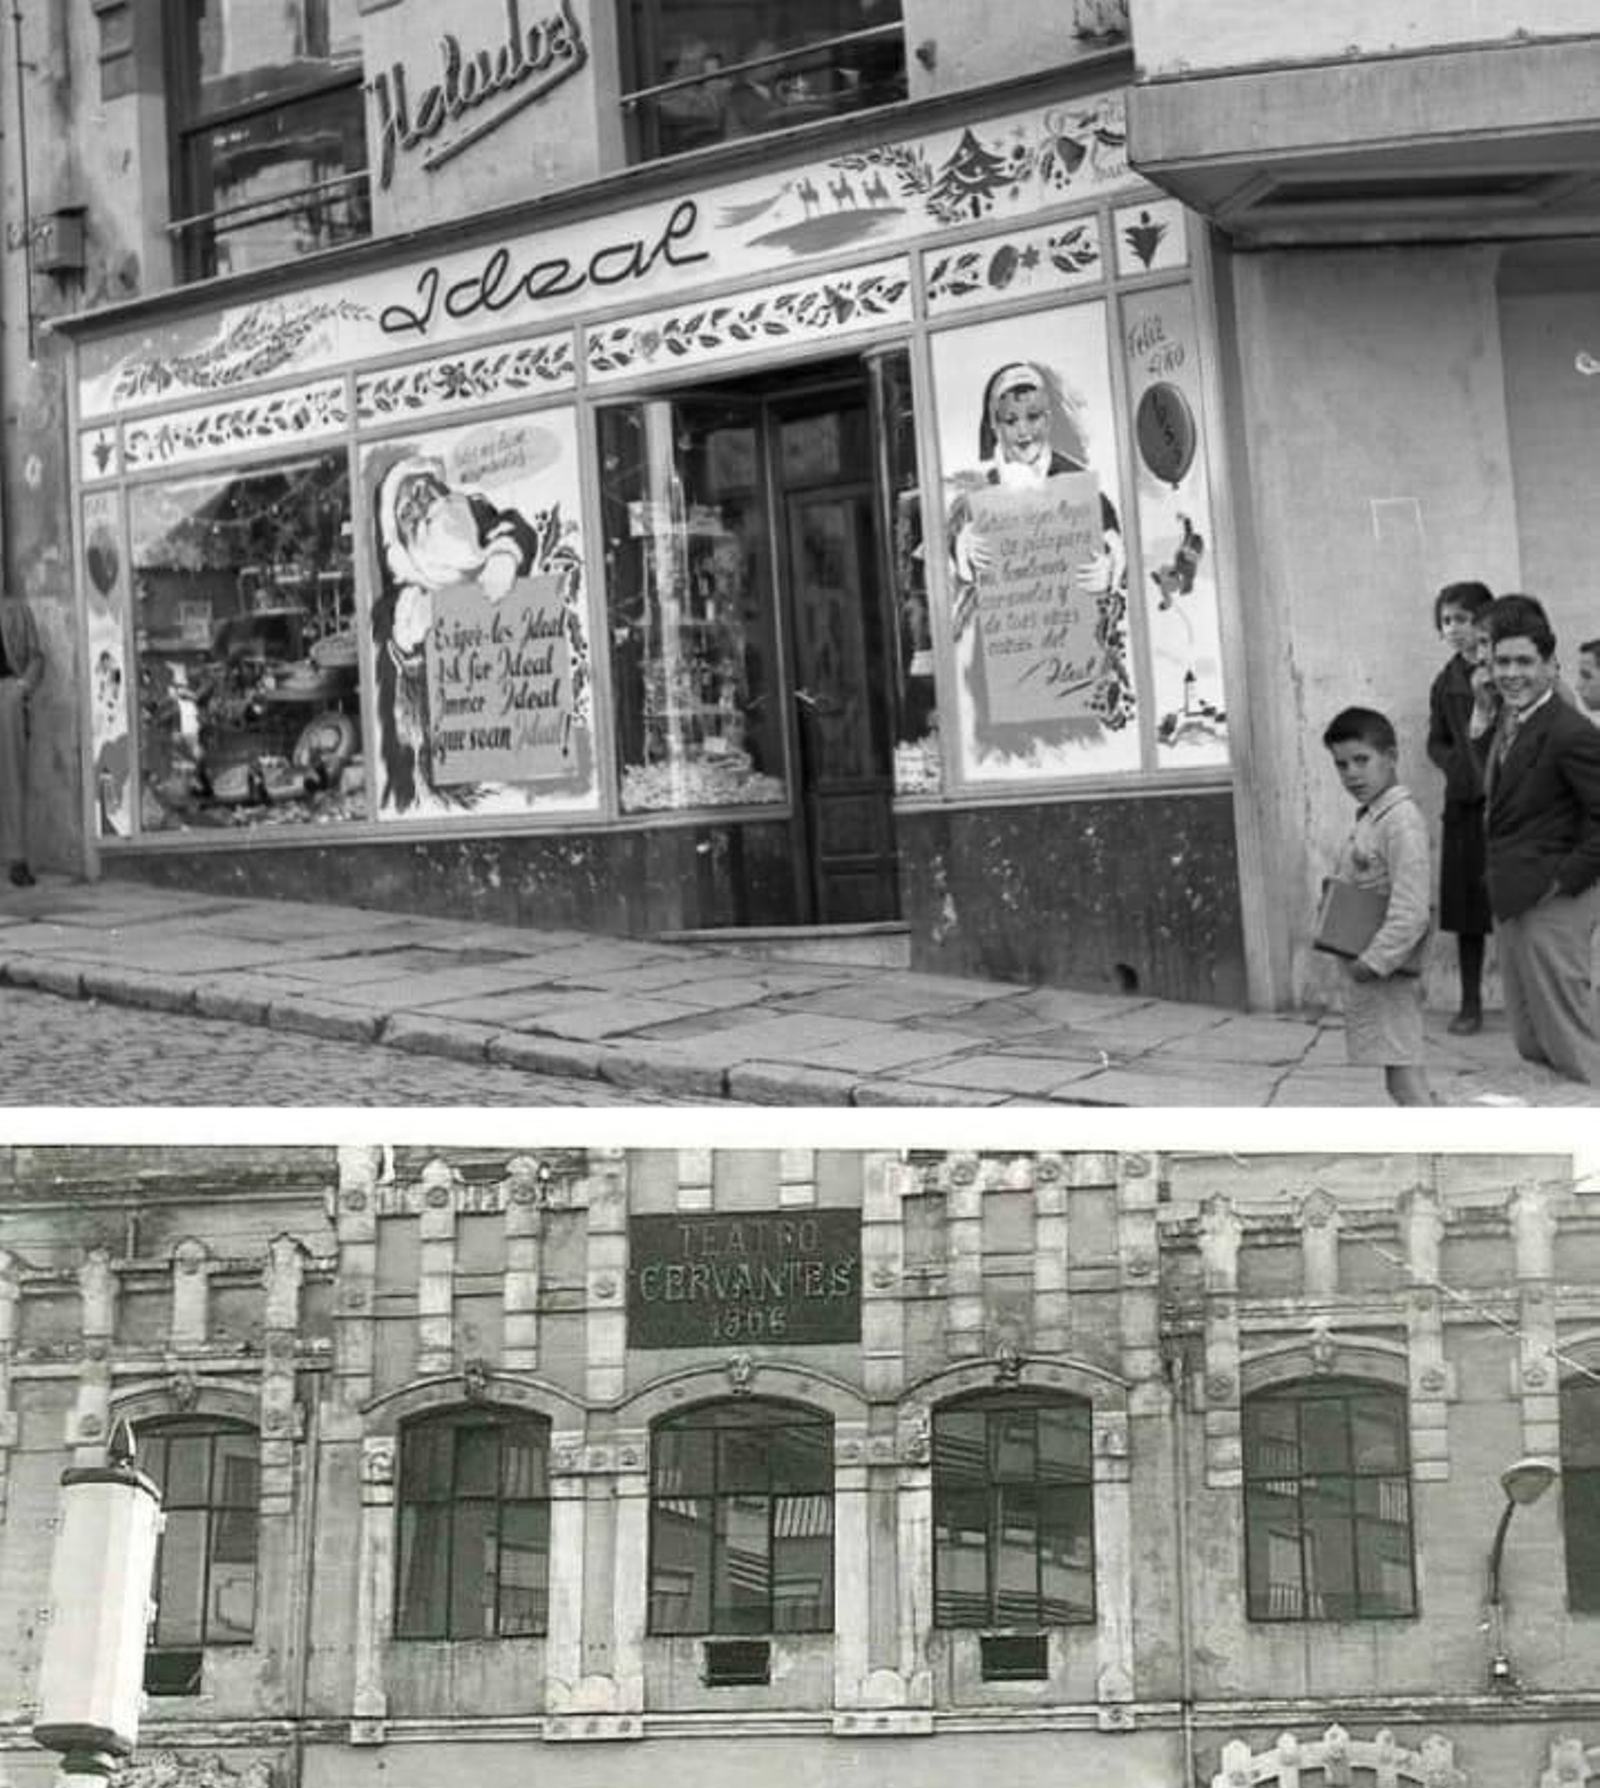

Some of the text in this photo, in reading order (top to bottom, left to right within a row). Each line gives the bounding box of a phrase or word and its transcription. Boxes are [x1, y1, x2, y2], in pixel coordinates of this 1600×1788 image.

[379, 200, 709, 334] Ideal
[518, 606, 567, 651] Ideal
[498, 645, 554, 684] Ideal
[500, 677, 561, 717] Ideal
